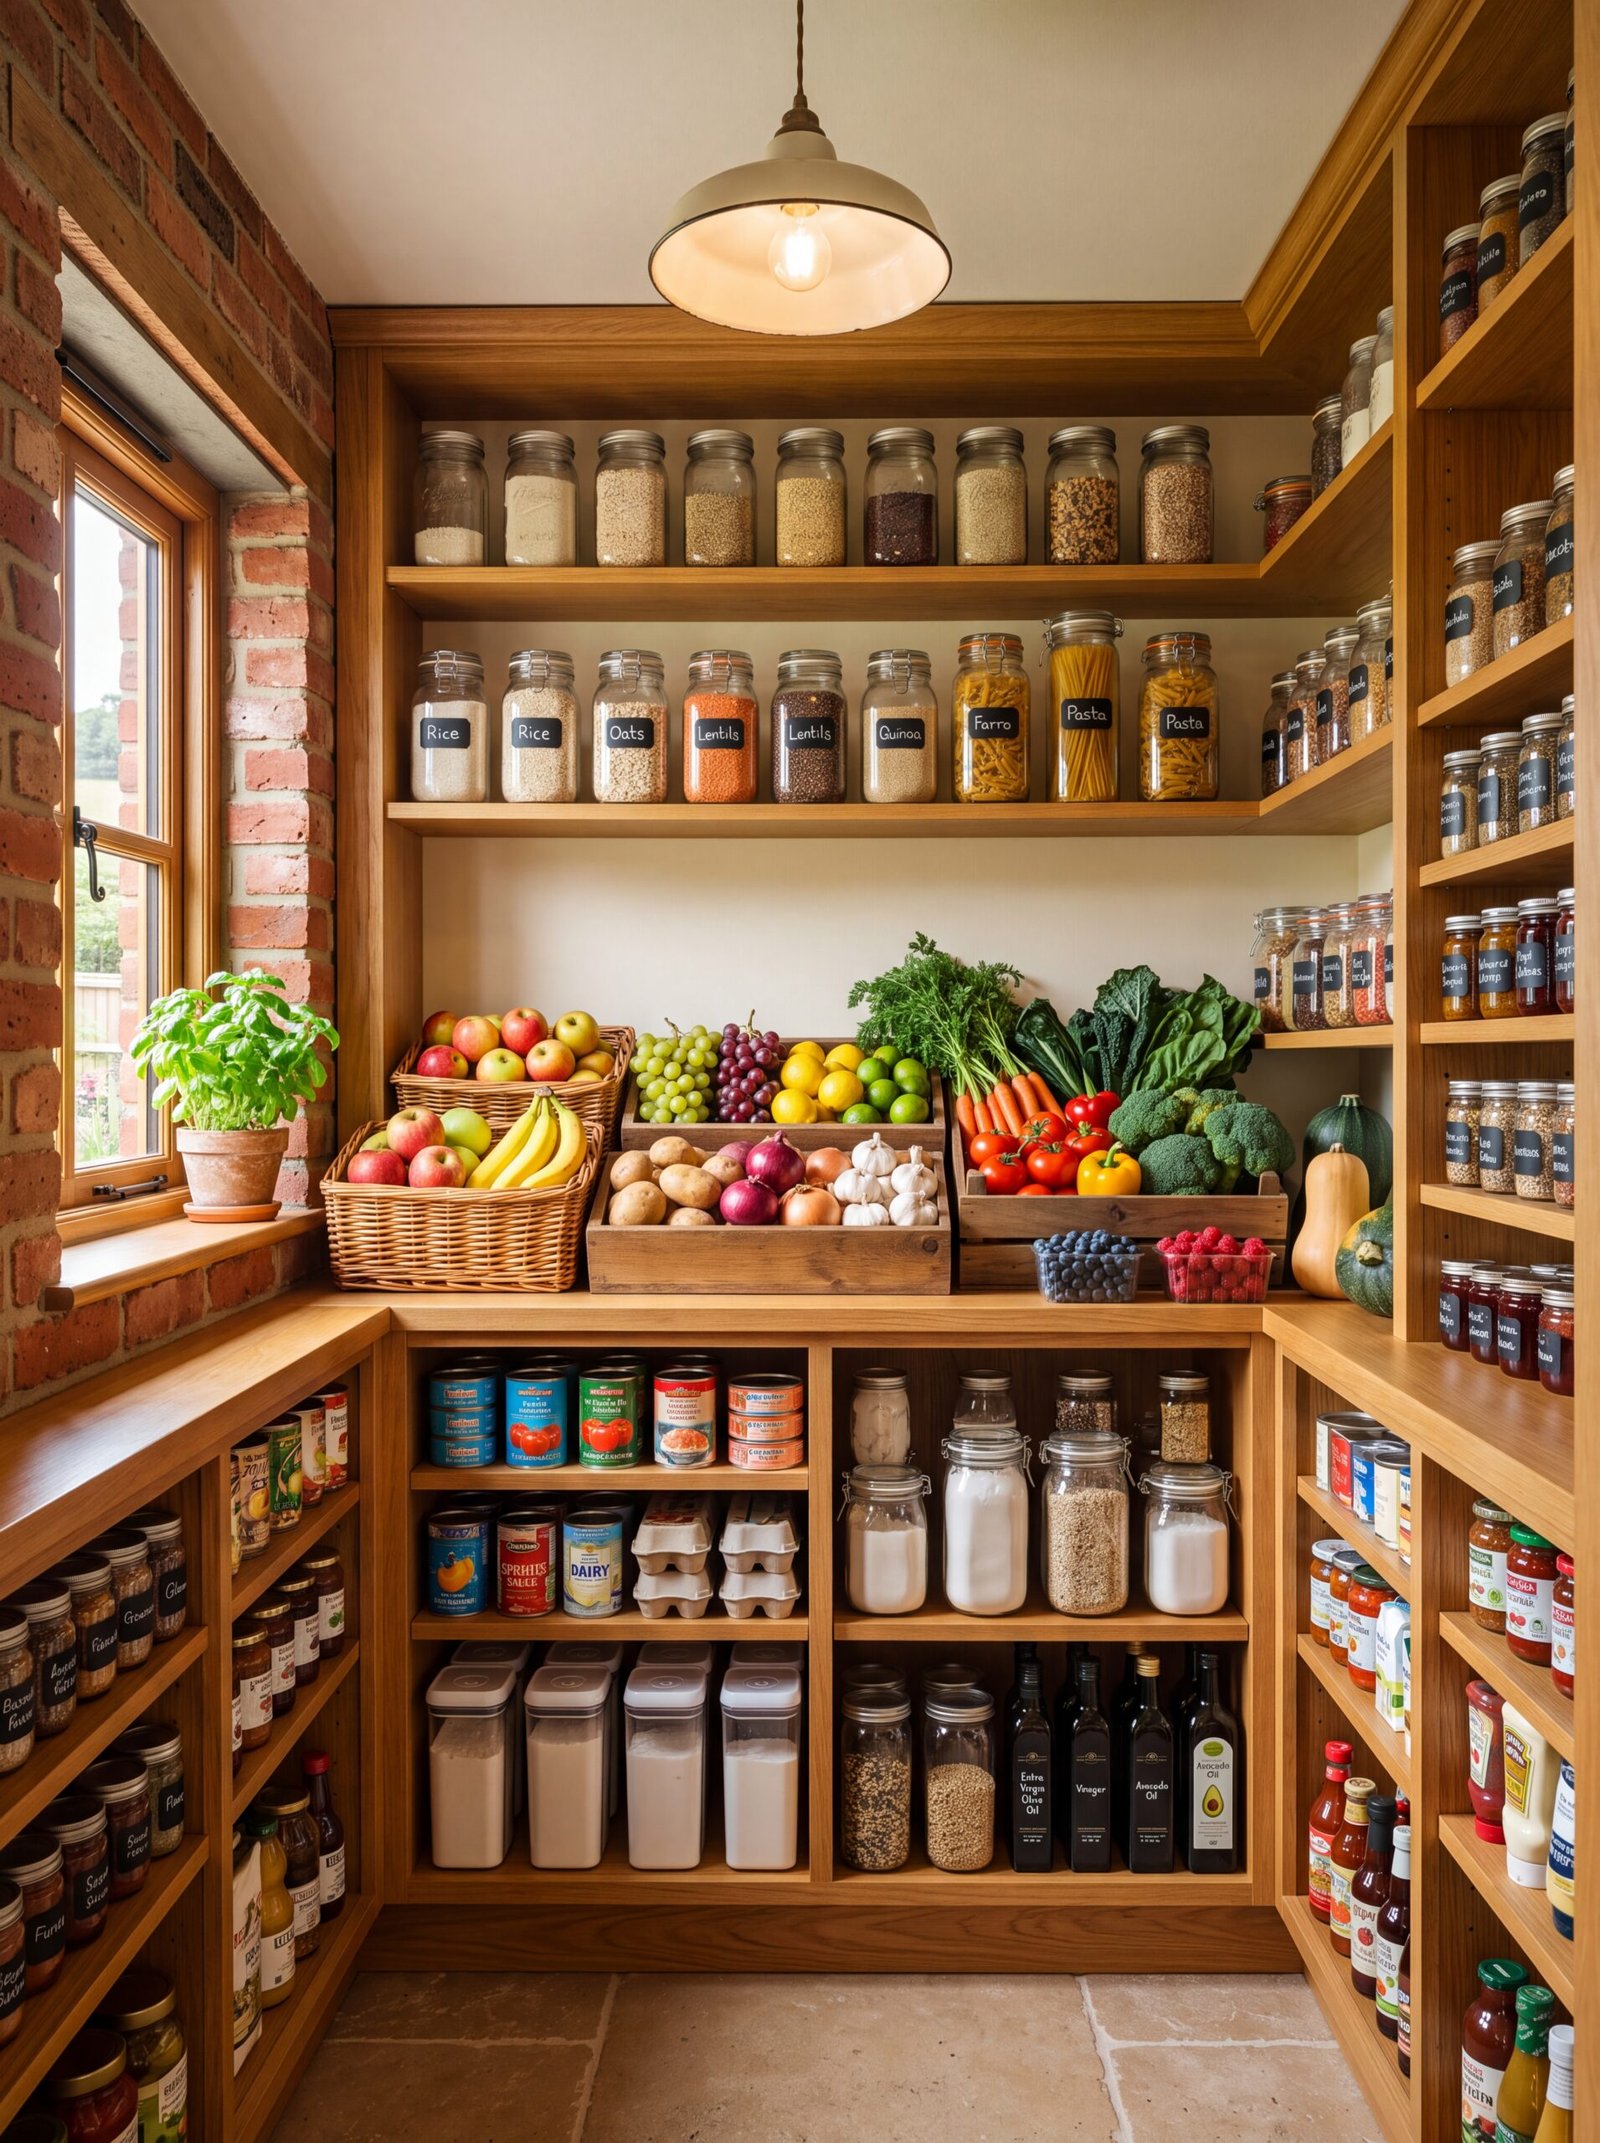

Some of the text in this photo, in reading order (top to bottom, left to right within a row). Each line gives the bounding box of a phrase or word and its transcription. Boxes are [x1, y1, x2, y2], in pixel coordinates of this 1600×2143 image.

[1067, 705, 1108, 721] Pasta
[1166, 711, 1204, 729] Pasta
[974, 715, 1012, 730] Farro
[427, 724, 460, 740] Rice
[518, 724, 550, 740] Rice
[609, 725, 645, 741] Oats
[698, 724, 740, 741] Lentils
[789, 724, 832, 741] Lentils
[571, 1564, 610, 1578] DAIRY
[1145, 1791, 1158, 1800] Oil
[1026, 1805, 1039, 1815] Oil
